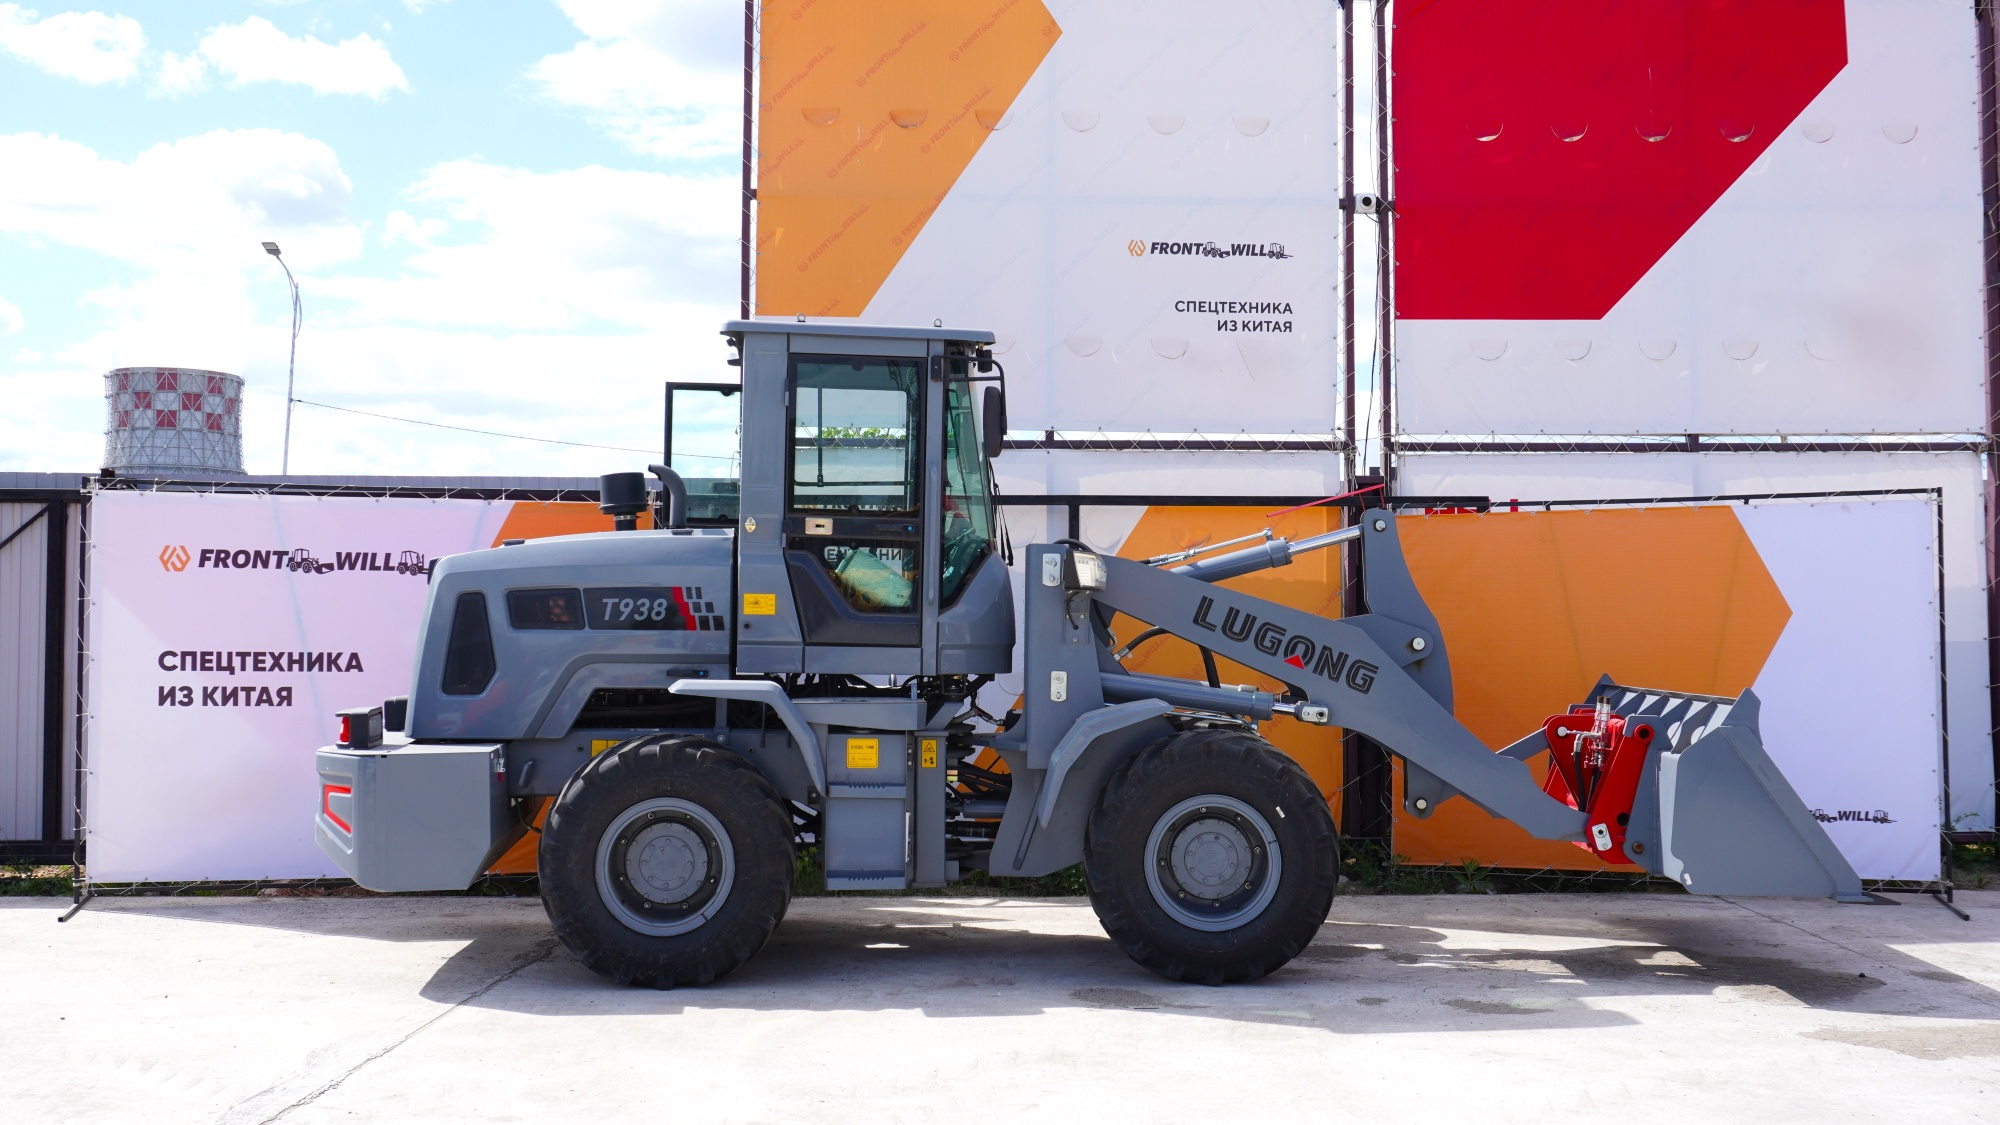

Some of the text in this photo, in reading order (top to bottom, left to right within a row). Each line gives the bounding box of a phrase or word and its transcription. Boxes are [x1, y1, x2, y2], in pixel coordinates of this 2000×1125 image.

[1150, 242, 1268, 257] FRONT WILL
[1174, 300, 1293, 315] СПЕЦТЕХНИКА
[1217, 320, 1293, 333] ИЗ КИТАЯ
[198, 548, 399, 572] FRONT WILL
[602, 598, 668, 621] T938
[1192, 595, 1380, 695] LUGONG
[157, 650, 364, 676] СПЕЦТЕХНИКА
[157, 685, 293, 707] ИЗ КИТАЯ
[1837, 810, 1873, 822] WILL
